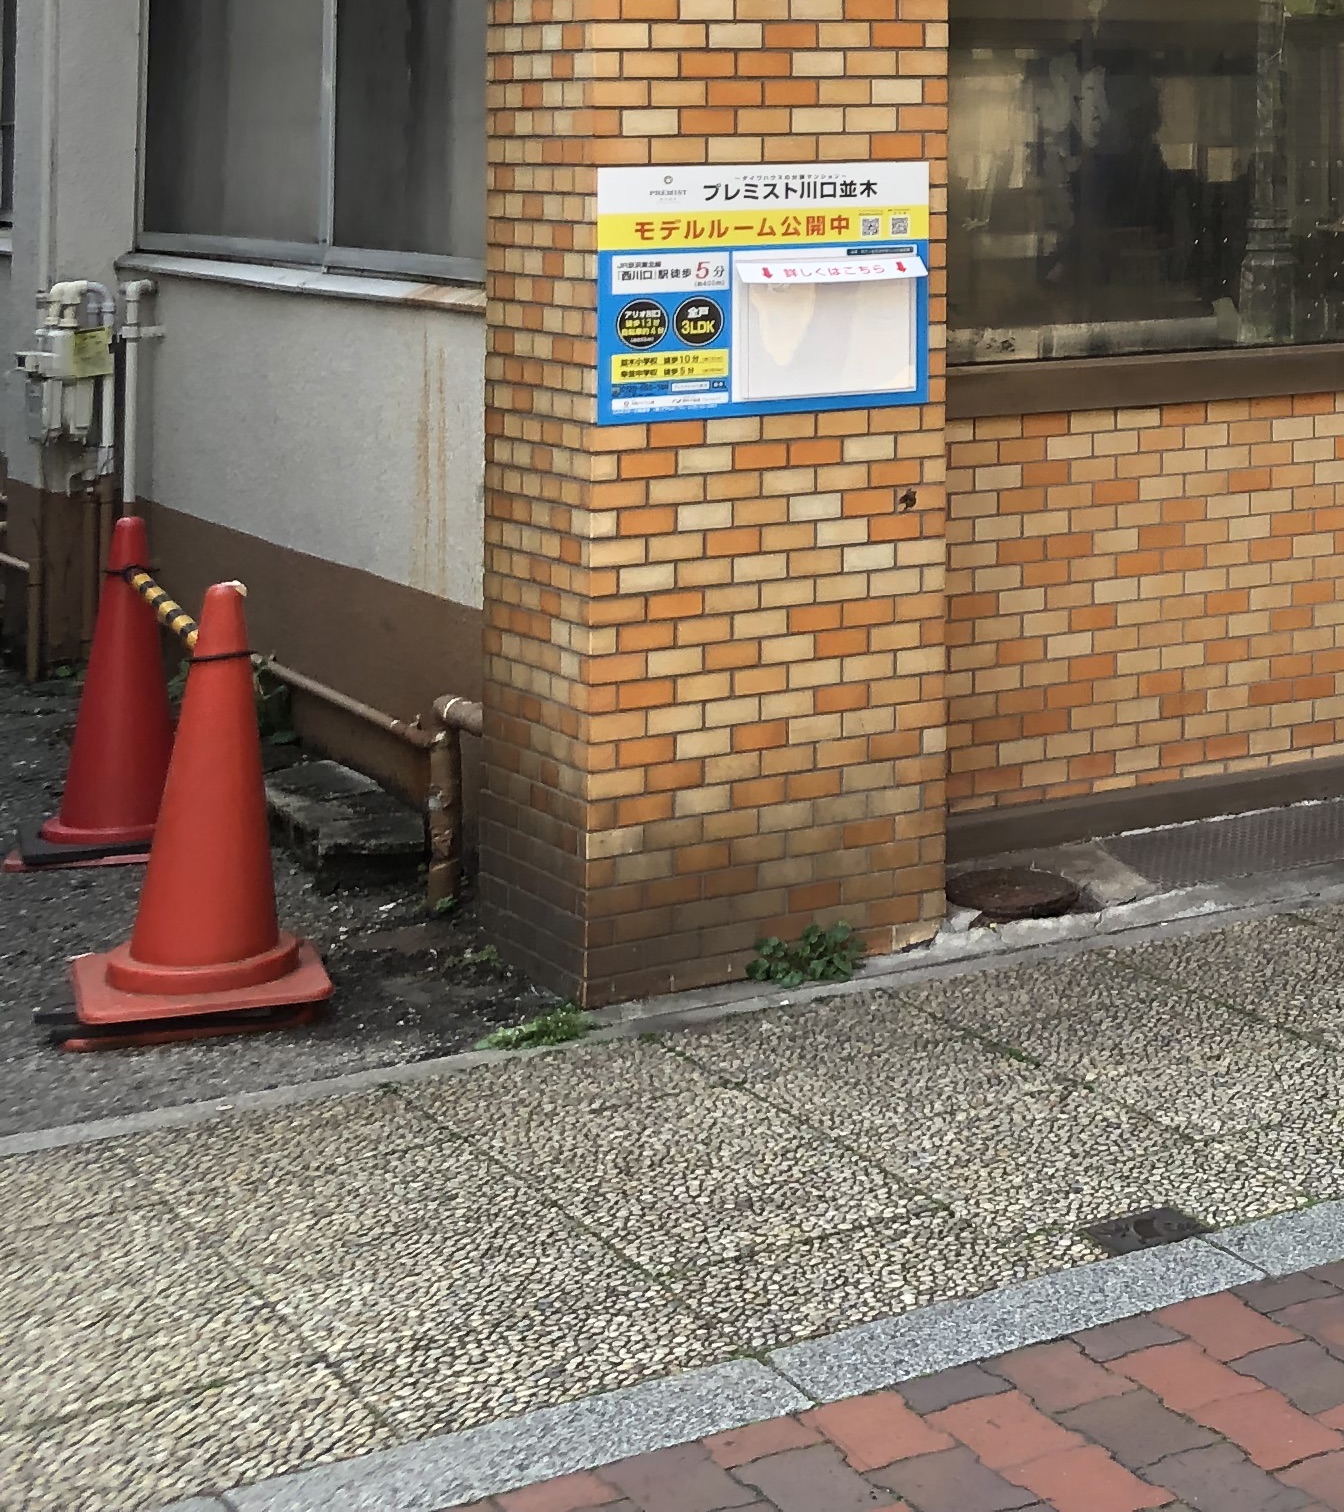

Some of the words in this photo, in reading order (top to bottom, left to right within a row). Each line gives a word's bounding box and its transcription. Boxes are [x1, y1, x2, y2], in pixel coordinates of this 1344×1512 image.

[703, 179, 878, 202] プレミスト川口並木
[634, 215, 850, 241] モデルルーム公開中
[783, 265, 886, 278] 詳しくはこちら
[681, 319, 716, 335] 3LDK
